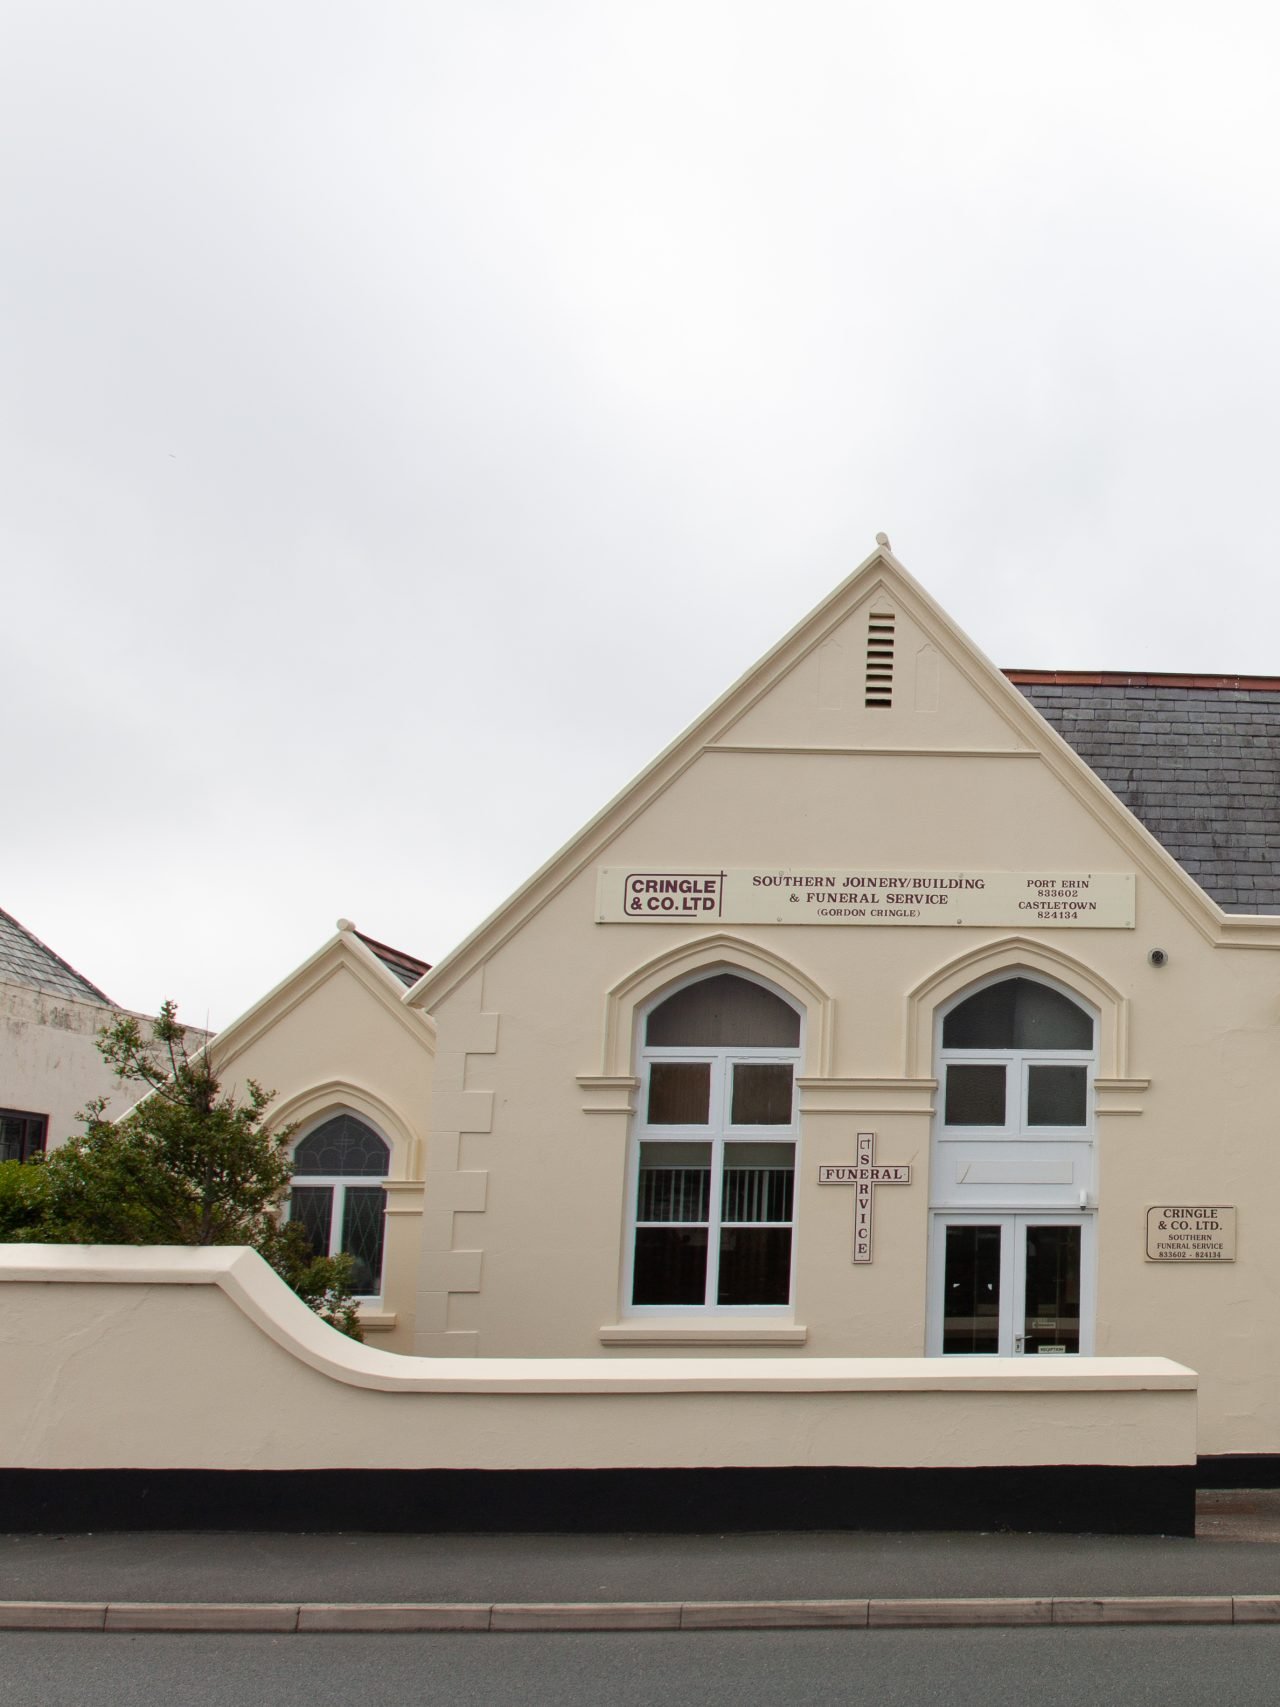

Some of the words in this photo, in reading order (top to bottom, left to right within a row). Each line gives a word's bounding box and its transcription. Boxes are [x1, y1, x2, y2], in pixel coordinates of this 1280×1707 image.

[632, 880, 716, 894] CRINGLE
[752, 876, 836, 887] SOUTHERN
[842, 876, 985, 889] JOINERY/BUILDING
[1027, 880, 1056, 888] PORT
[1062, 880, 1089, 888] ERIN
[789, 893, 800, 903] &
[806, 892, 879, 904] FUNERAL
[886, 893, 948, 905] SERVICE
[1037, 889, 1078, 898] 833602
[631, 897, 642, 911] &
[682, 897, 715, 911] LTD
[1018, 901, 1097, 910] CASTLETOWN
[816, 908, 866, 918] (GORDON
[870, 908, 921, 919] CRINGLE)
[1037, 911, 1078, 919] 824134
[825, 1168, 903, 1180] FUNERAL
[858, 1154, 870, 1254] SERVICE
[1163, 1208, 1218, 1219] CRINGLE
[1158, 1220, 1168, 1230] &
[1170, 1220, 1193, 1231] CO.
[1196, 1220, 1223, 1231] LTD.
[1157, 1242, 1190, 1250] FUNERAL
[1192, 1242, 1224, 1250] SERVICE
